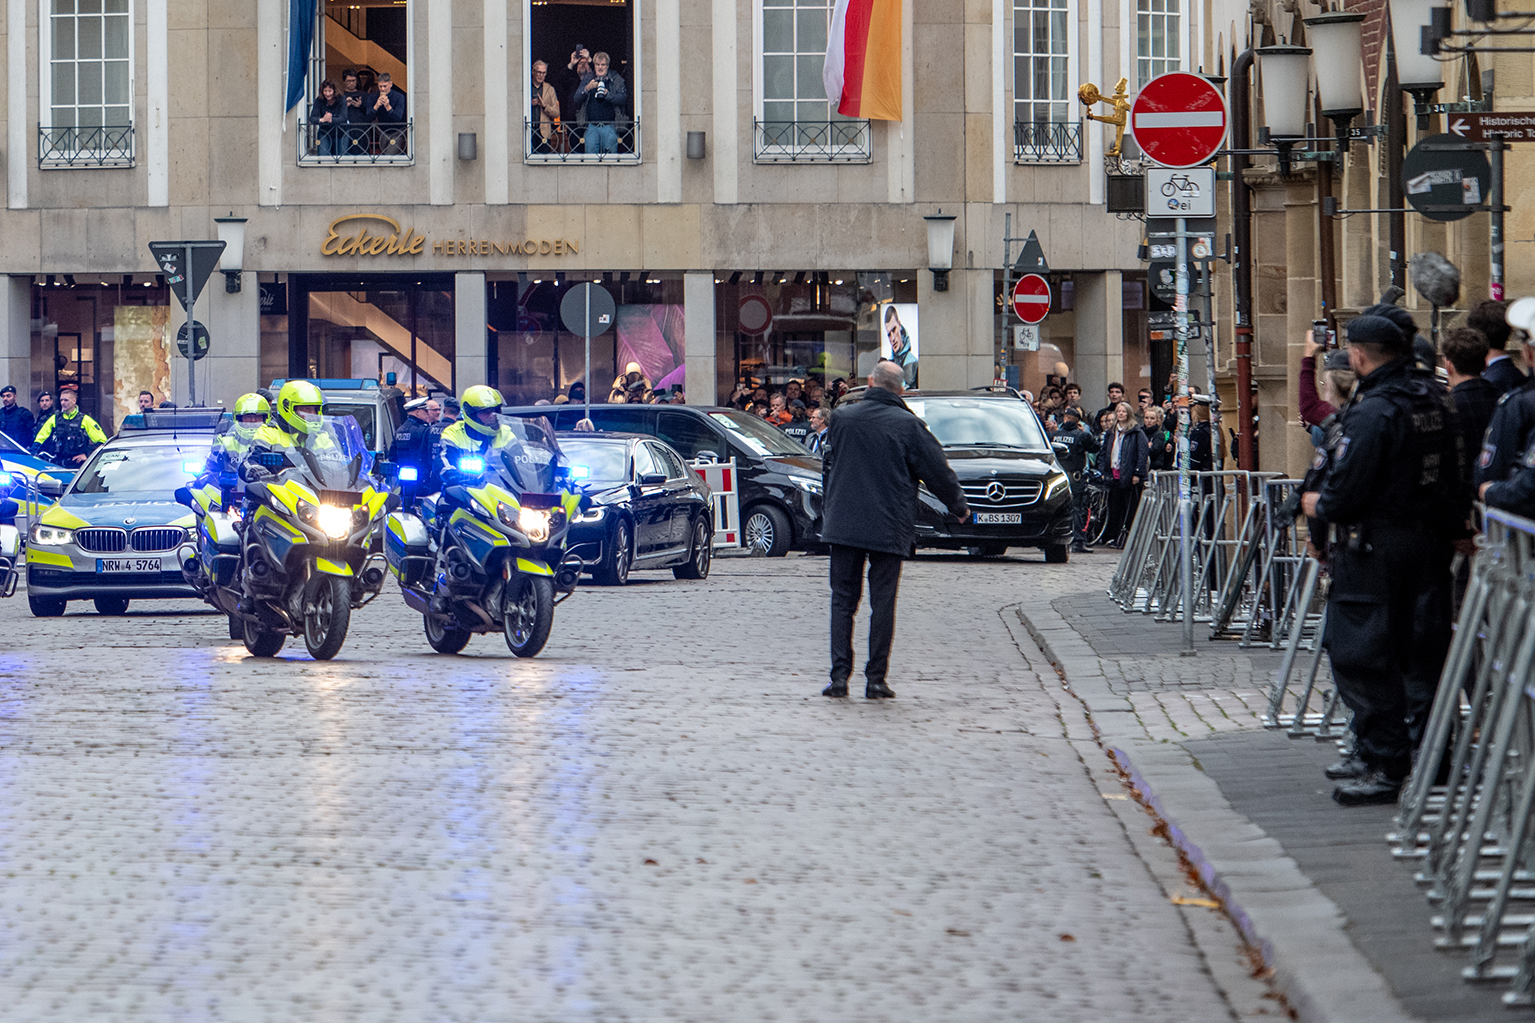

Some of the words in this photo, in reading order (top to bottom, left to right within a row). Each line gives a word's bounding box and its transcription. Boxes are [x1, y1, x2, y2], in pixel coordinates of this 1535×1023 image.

[320, 213, 426, 256] Eckerle
[432, 238, 580, 256] HERRENMODEN
[785, 428, 806, 436] POLIZEI
[1053, 435, 1074, 444] POLIZEI
[978, 514, 984, 523] K
[988, 514, 1000, 523] BS
[1000, 514, 1020, 523] 1307
[102, 560, 120, 571] NRW
